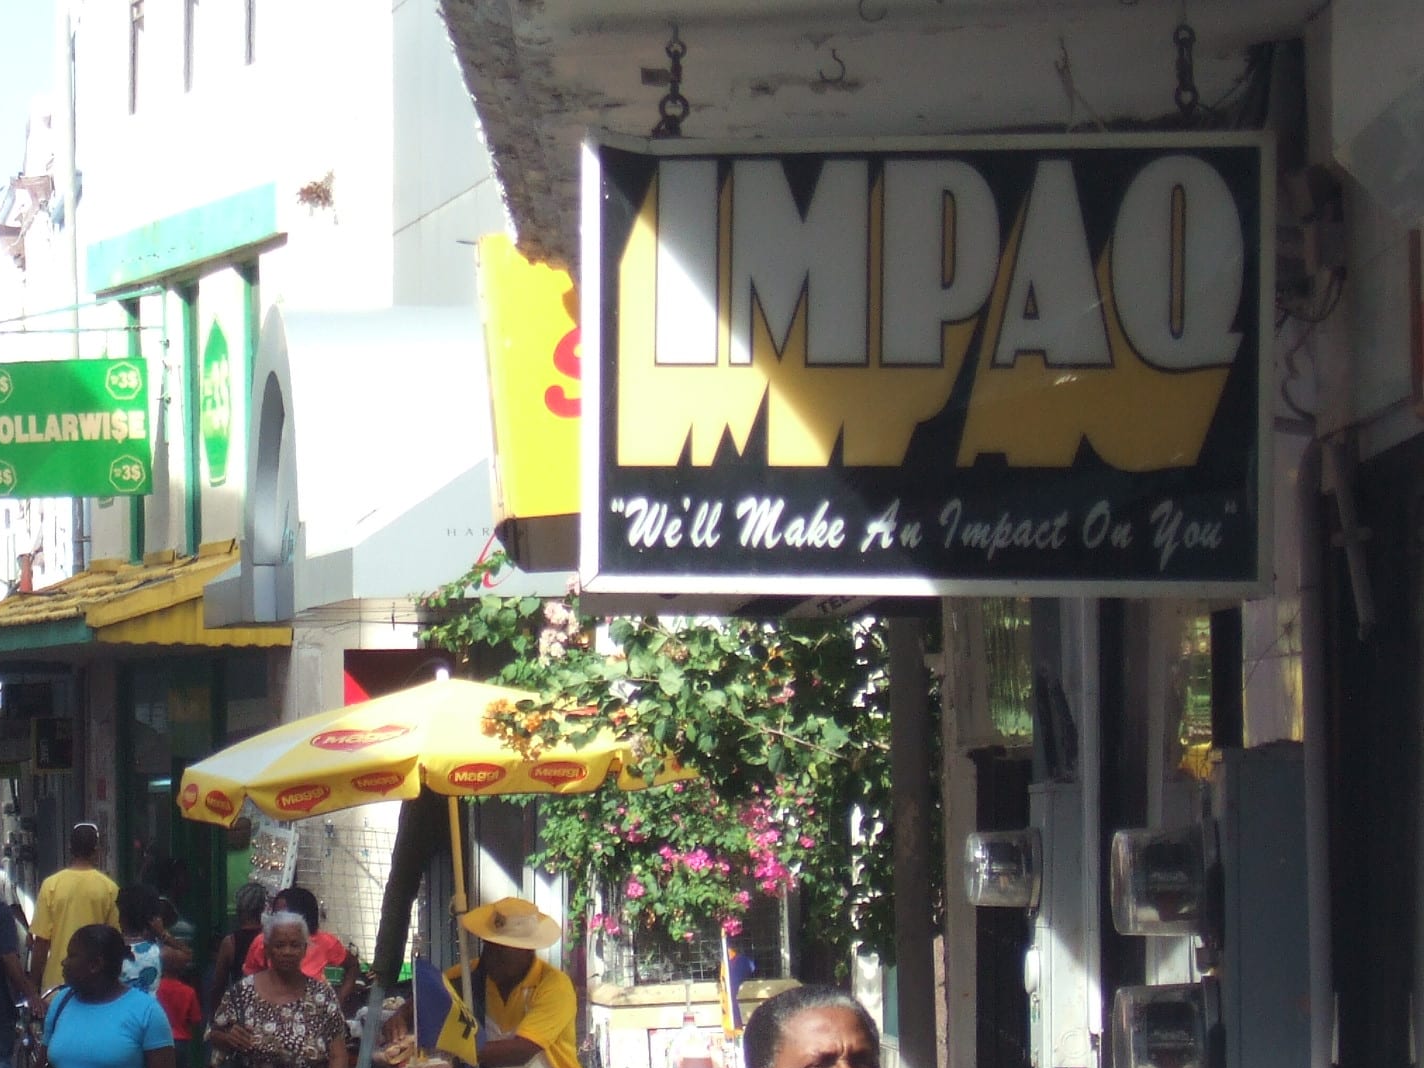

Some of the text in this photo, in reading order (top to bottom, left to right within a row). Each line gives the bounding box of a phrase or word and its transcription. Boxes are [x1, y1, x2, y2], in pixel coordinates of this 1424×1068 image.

[655, 155, 1247, 369] IMPAQ
[736, 497, 846, 549] Make
[860, 498, 922, 552] An
[939, 498, 1070, 561] Impact
[1082, 499, 1133, 549] On
[454, 770, 500, 783] Maggi
